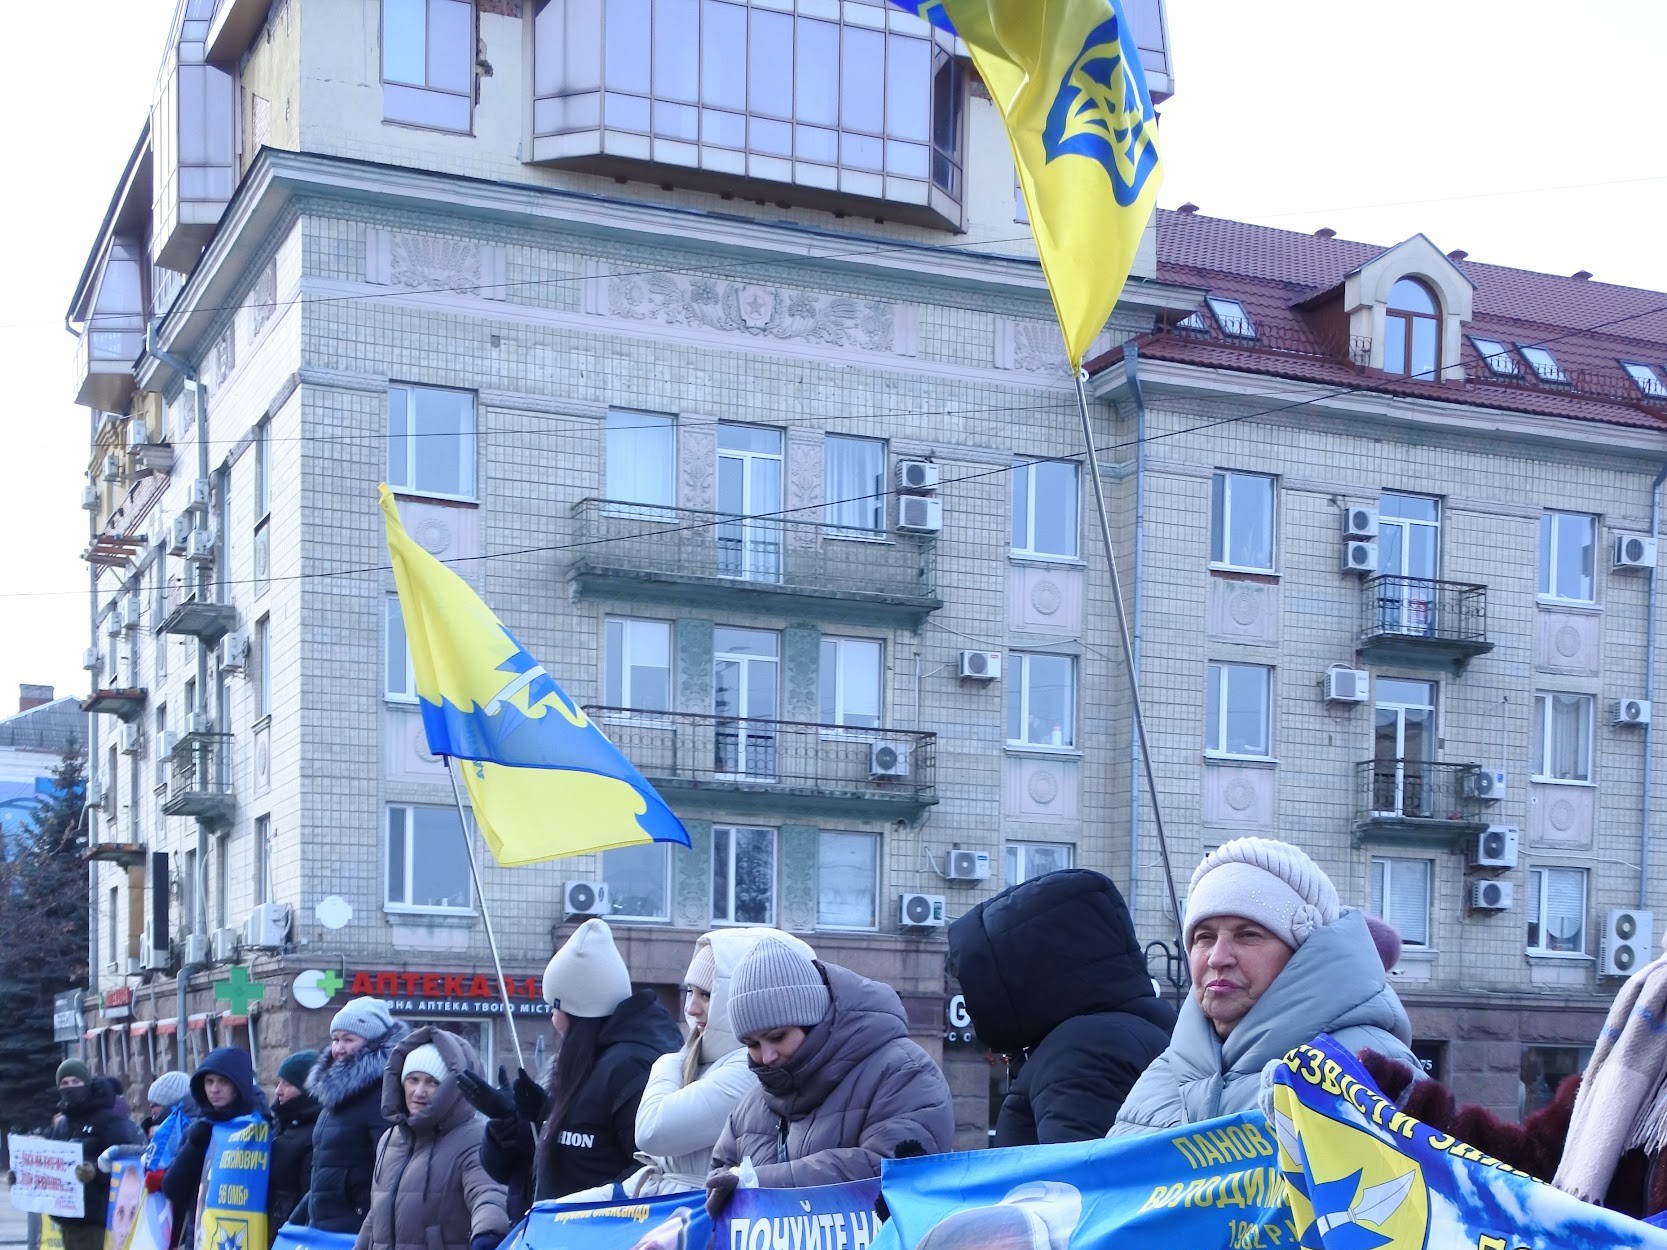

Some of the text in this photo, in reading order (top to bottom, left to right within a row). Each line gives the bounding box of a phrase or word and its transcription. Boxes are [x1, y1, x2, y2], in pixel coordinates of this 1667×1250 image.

[351, 971, 498, 998] АПТЕКА
[386, 1000, 554, 1014] ВНА АПТЕКА ТВОГО МІСТ
[1282, 1043, 1420, 1139] ЕЗВІСТИ
[1172, 1122, 1275, 1170] ПАНОВ
